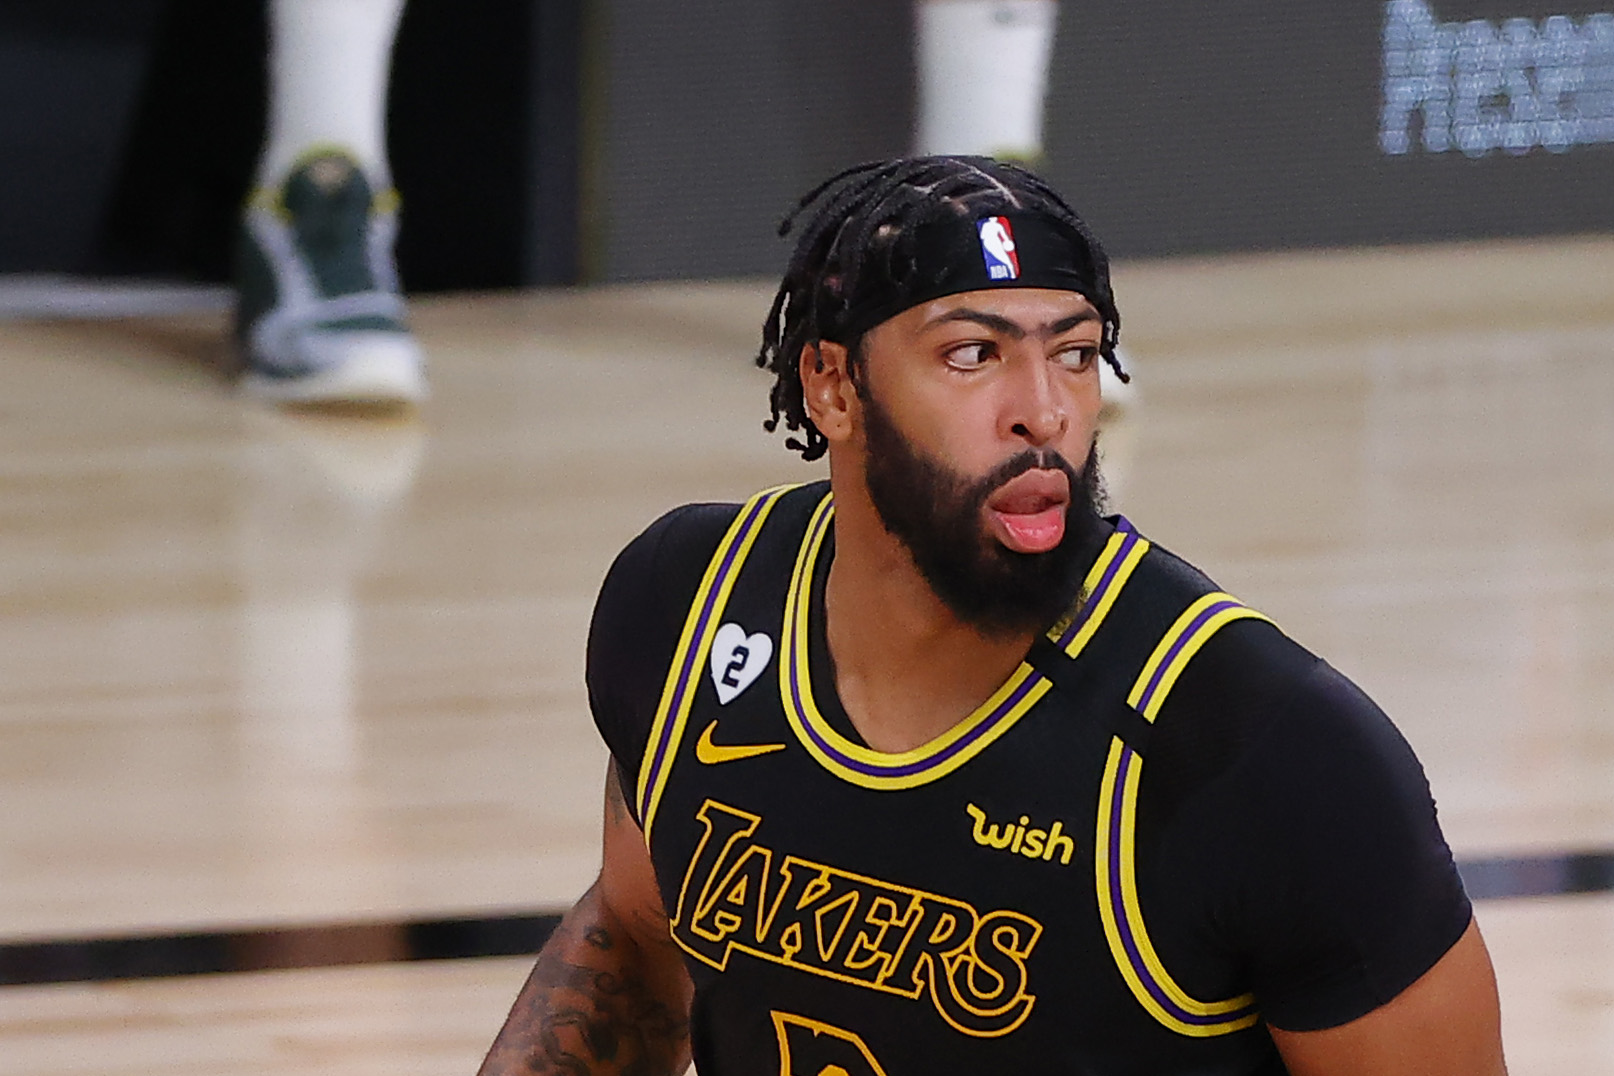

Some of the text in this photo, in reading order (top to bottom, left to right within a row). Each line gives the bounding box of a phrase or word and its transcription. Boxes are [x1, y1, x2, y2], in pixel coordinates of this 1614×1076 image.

[721, 644, 750, 689] 2
[966, 803, 1074, 865] wish
[669, 798, 1044, 1038] LAKERS
